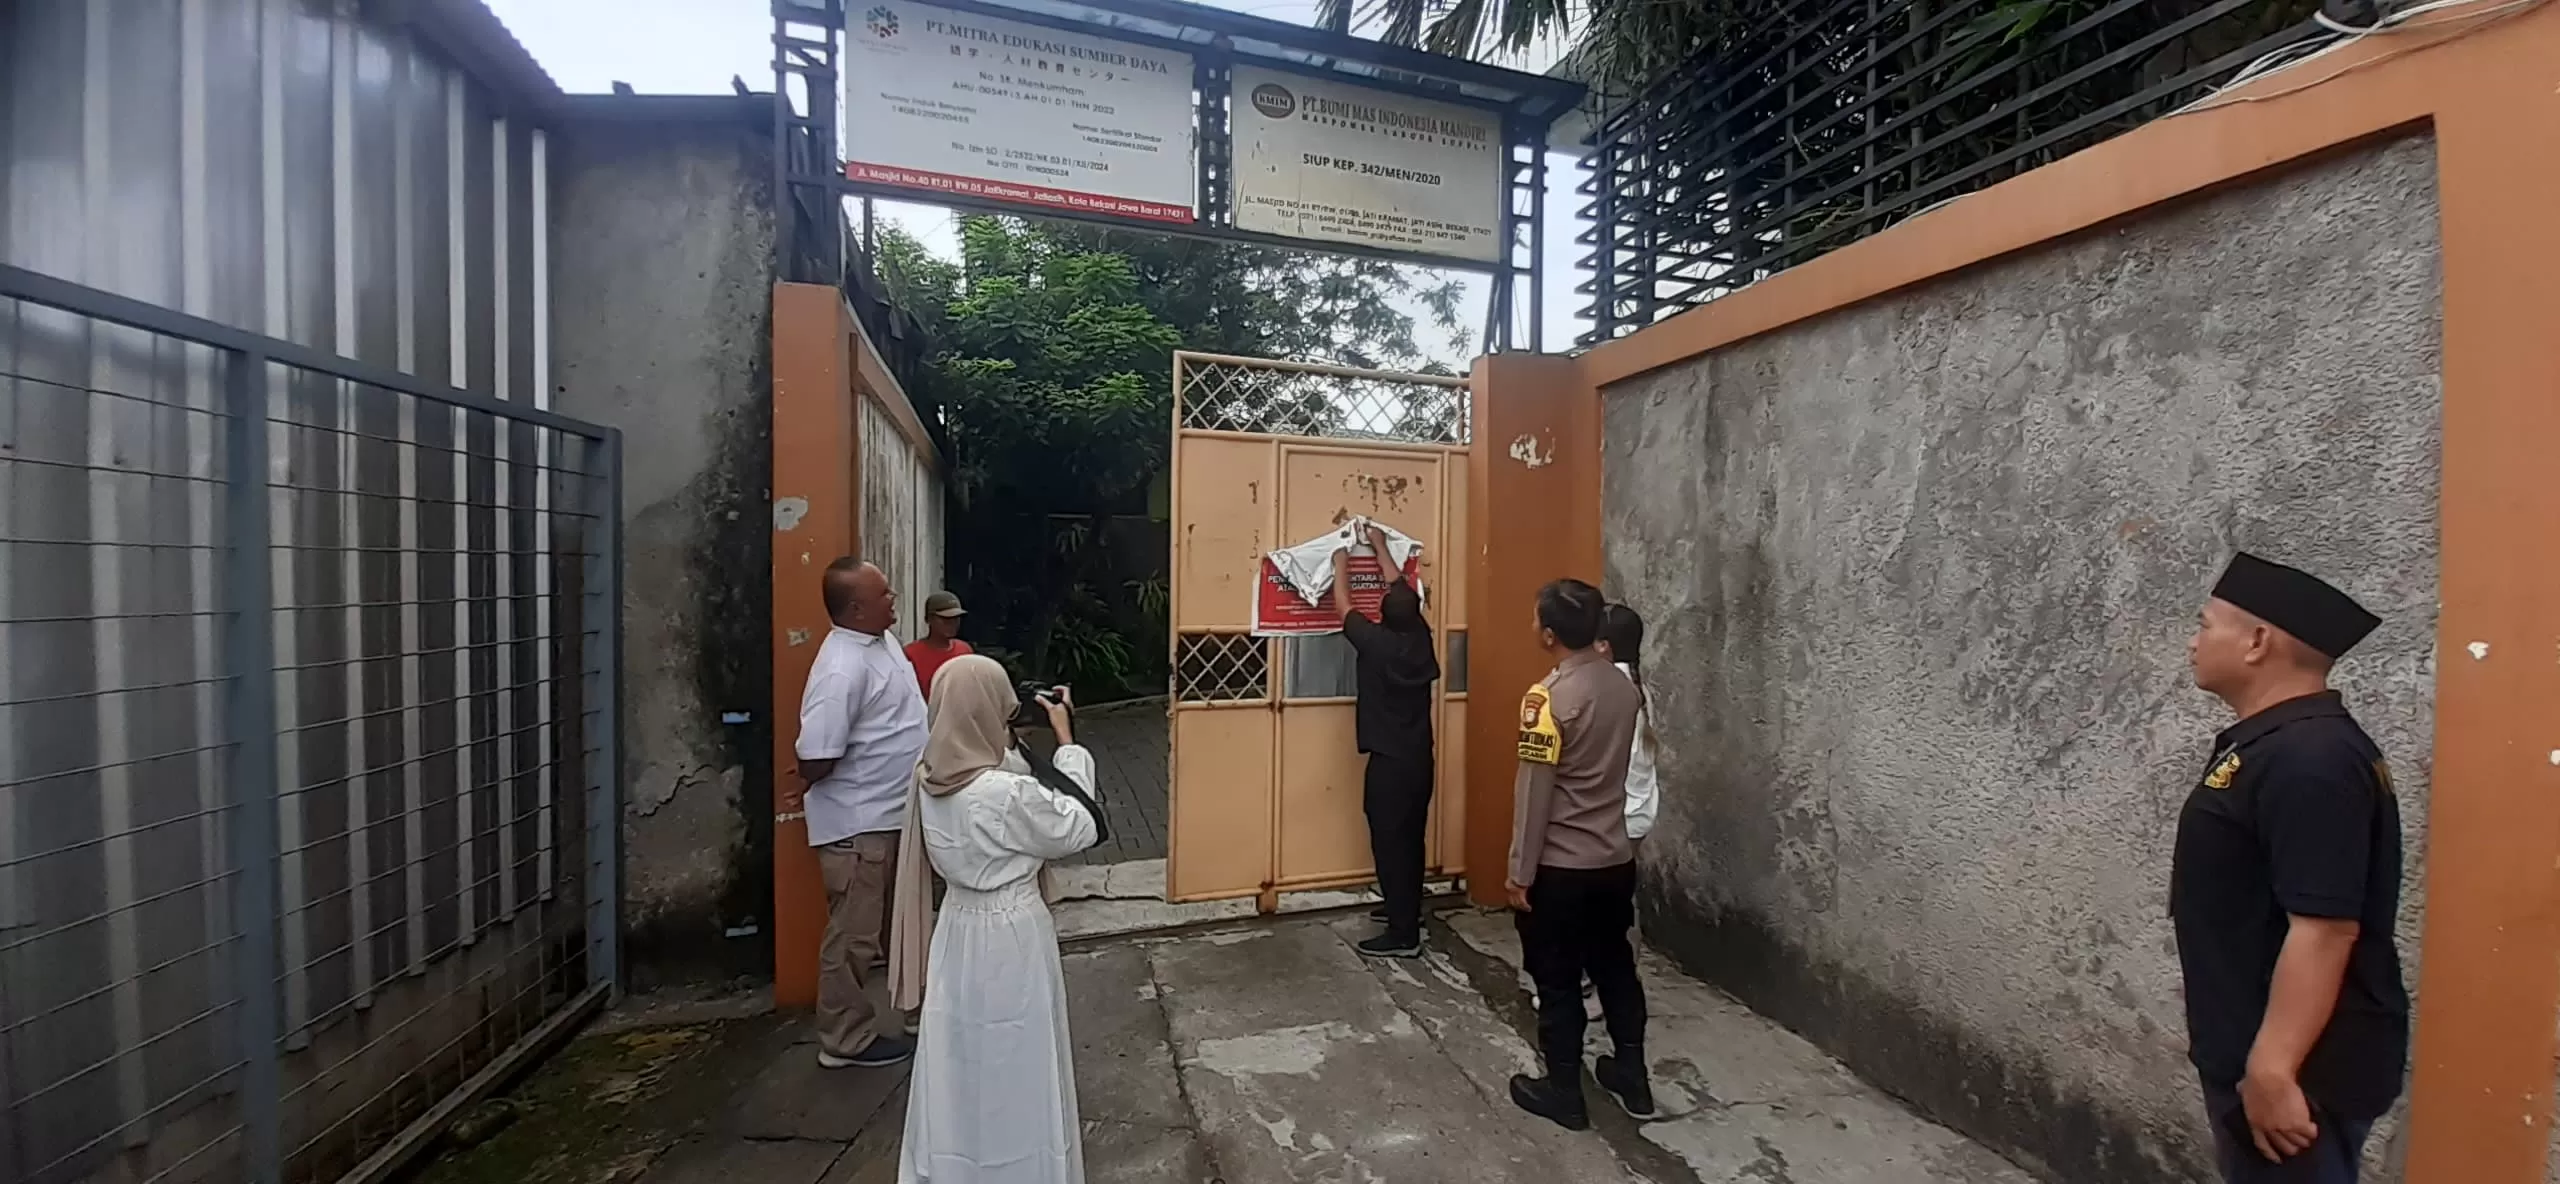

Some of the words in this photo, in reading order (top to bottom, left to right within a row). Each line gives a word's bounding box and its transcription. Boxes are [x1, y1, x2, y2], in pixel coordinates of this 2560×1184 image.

[926, 19, 999, 44] PT.MITRA
[1003, 34, 1066, 56] EDUKASI
[1070, 46, 1127, 67] SUMBER
[1129, 57, 1168, 74] DAYA
[1302, 95, 1350, 119] PT.BUMI
[1352, 103, 1377, 122] MAS
[1379, 109, 1439, 135] INDONESIA
[1440, 120, 1487, 142] MANDIRI
[869, 169, 901, 183] Masjid
[1303, 153, 1330, 167] SIUP
[1333, 158, 1358, 172] KEP.
[1360, 163, 1441, 185] 342/MEN/2020
[1256, 196, 1285, 207] MASJID
